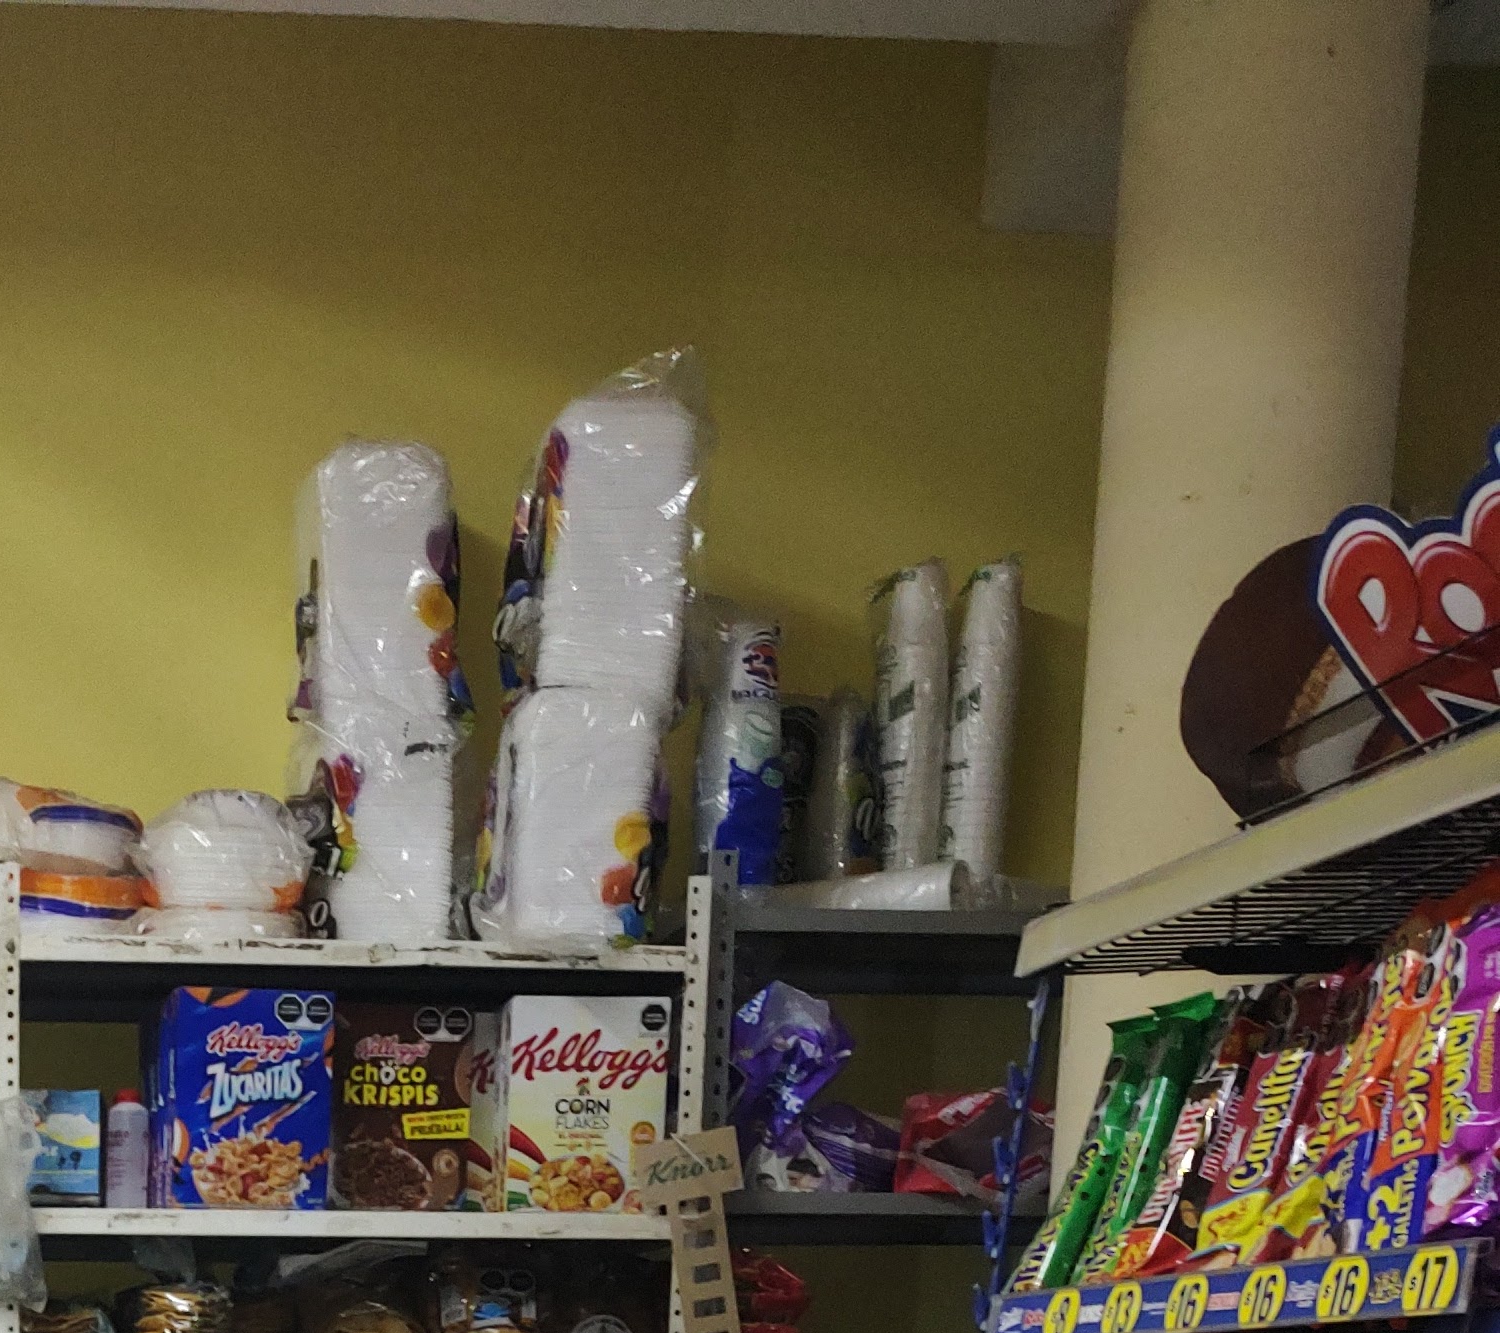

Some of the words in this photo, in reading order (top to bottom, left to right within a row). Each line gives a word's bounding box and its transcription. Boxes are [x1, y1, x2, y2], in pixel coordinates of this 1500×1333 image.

[206, 1020, 304, 1063] Kellogg's
[510, 1026, 671, 1090] Kellogg's
[205, 1058, 304, 1120] ZUCARITAS
[343, 1082, 440, 1107] KRISPIS
[1438, 1010, 1483, 1147] SPONCH
[555, 1098, 611, 1115] CORN
[555, 1116, 610, 1130] FLAKES
